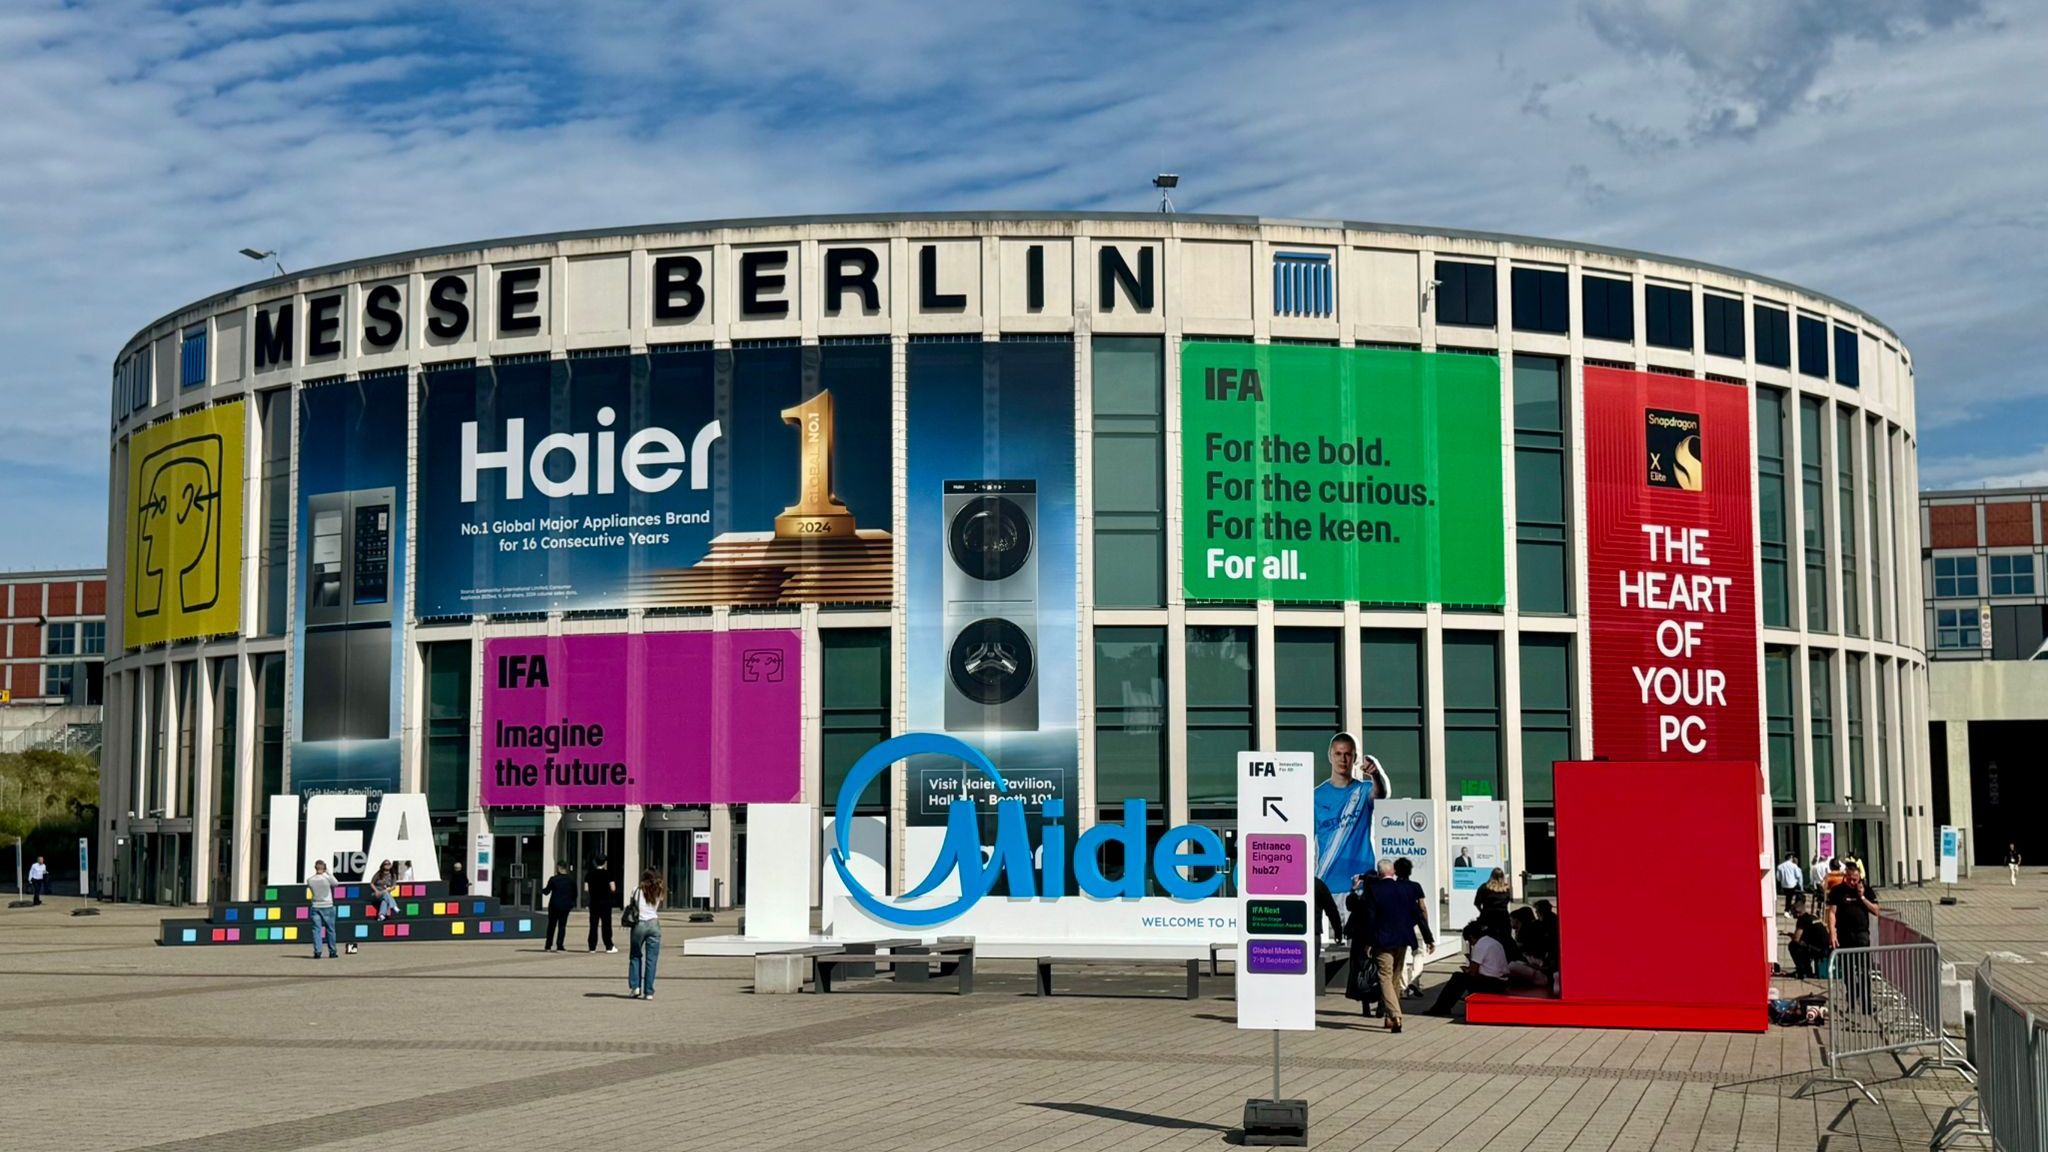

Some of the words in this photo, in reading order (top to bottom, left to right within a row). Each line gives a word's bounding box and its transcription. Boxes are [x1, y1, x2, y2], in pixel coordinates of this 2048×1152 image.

[255, 267, 542, 367] MESSE
[655, 246, 1154, 319] BERLIN
[1205, 367, 1264, 402] IFA
[808, 412, 820, 443] NO.1
[1648, 413, 1697, 431] Snapdragon
[460, 406, 722, 503] Haier
[1206, 432, 1253, 463] For
[1261, 434, 1311, 464] the
[1318, 435, 1391, 467] bold.
[1650, 451, 1661, 471] X
[809, 447, 821, 504] GLOBAL
[1650, 471, 1667, 482] Elite
[1206, 471, 1253, 502] For
[1261, 473, 1311, 503] the
[1318, 476, 1435, 507] curious.
[461, 522, 489, 536] No.1
[492, 519, 535, 534] Global
[539, 517, 580, 533] Major
[583, 513, 661, 531] Appliances
[665, 510, 711, 525] Brand
[797, 521, 833, 534] 2024
[1206, 510, 1253, 541] For
[1262, 512, 1311, 542] the
[1318, 512, 1400, 544] keen.
[499, 538, 518, 552] for
[522, 537, 537, 551] 16
[541, 533, 625, 550] Consecutive
[629, 532, 670, 546] Years
[1641, 523, 1710, 567] THE
[1207, 548, 1254, 580] For
[1262, 549, 1307, 581] all.
[1619, 570, 1733, 614] HEART
[1656, 619, 1704, 658] OF
[498, 654, 550, 689] IFA
[1632, 665, 1727, 707] YOUR
[496, 717, 604, 753] Imagine
[1660, 714, 1707, 754] PC
[495, 757, 539, 787] the
[545, 757, 636, 787] future.
[1249, 762, 1276, 777] IFA
[929, 778, 957, 790] Visit
[962, 778, 996, 790] Haier
[1003, 778, 1056, 792] Pavilion,
[367, 802, 381, 812] 10
[929, 794, 954, 806] Hall
[1450, 804, 1462, 812] IFA
[830, 733, 1239, 927] Mide
[1381, 816, 1405, 828] Midea
[268, 793, 442, 885] IFA
[1252, 841, 1291, 850] Entrance
[1381, 838, 1415, 847] ERLING
[1252, 852, 1293, 863] Eingang
[1381, 847, 1428, 856] HAALAND
[1252, 865, 1280, 875] hub27
[1252, 906, 1263, 914] IFA
[1264, 906, 1280, 914] Next
[1142, 917, 1204, 927] WELCOME
[1208, 918, 1224, 928] TO
[1252, 946, 1274, 954] Global
[1275, 947, 1302, 955] Markets
[1266, 957, 1303, 965] September
